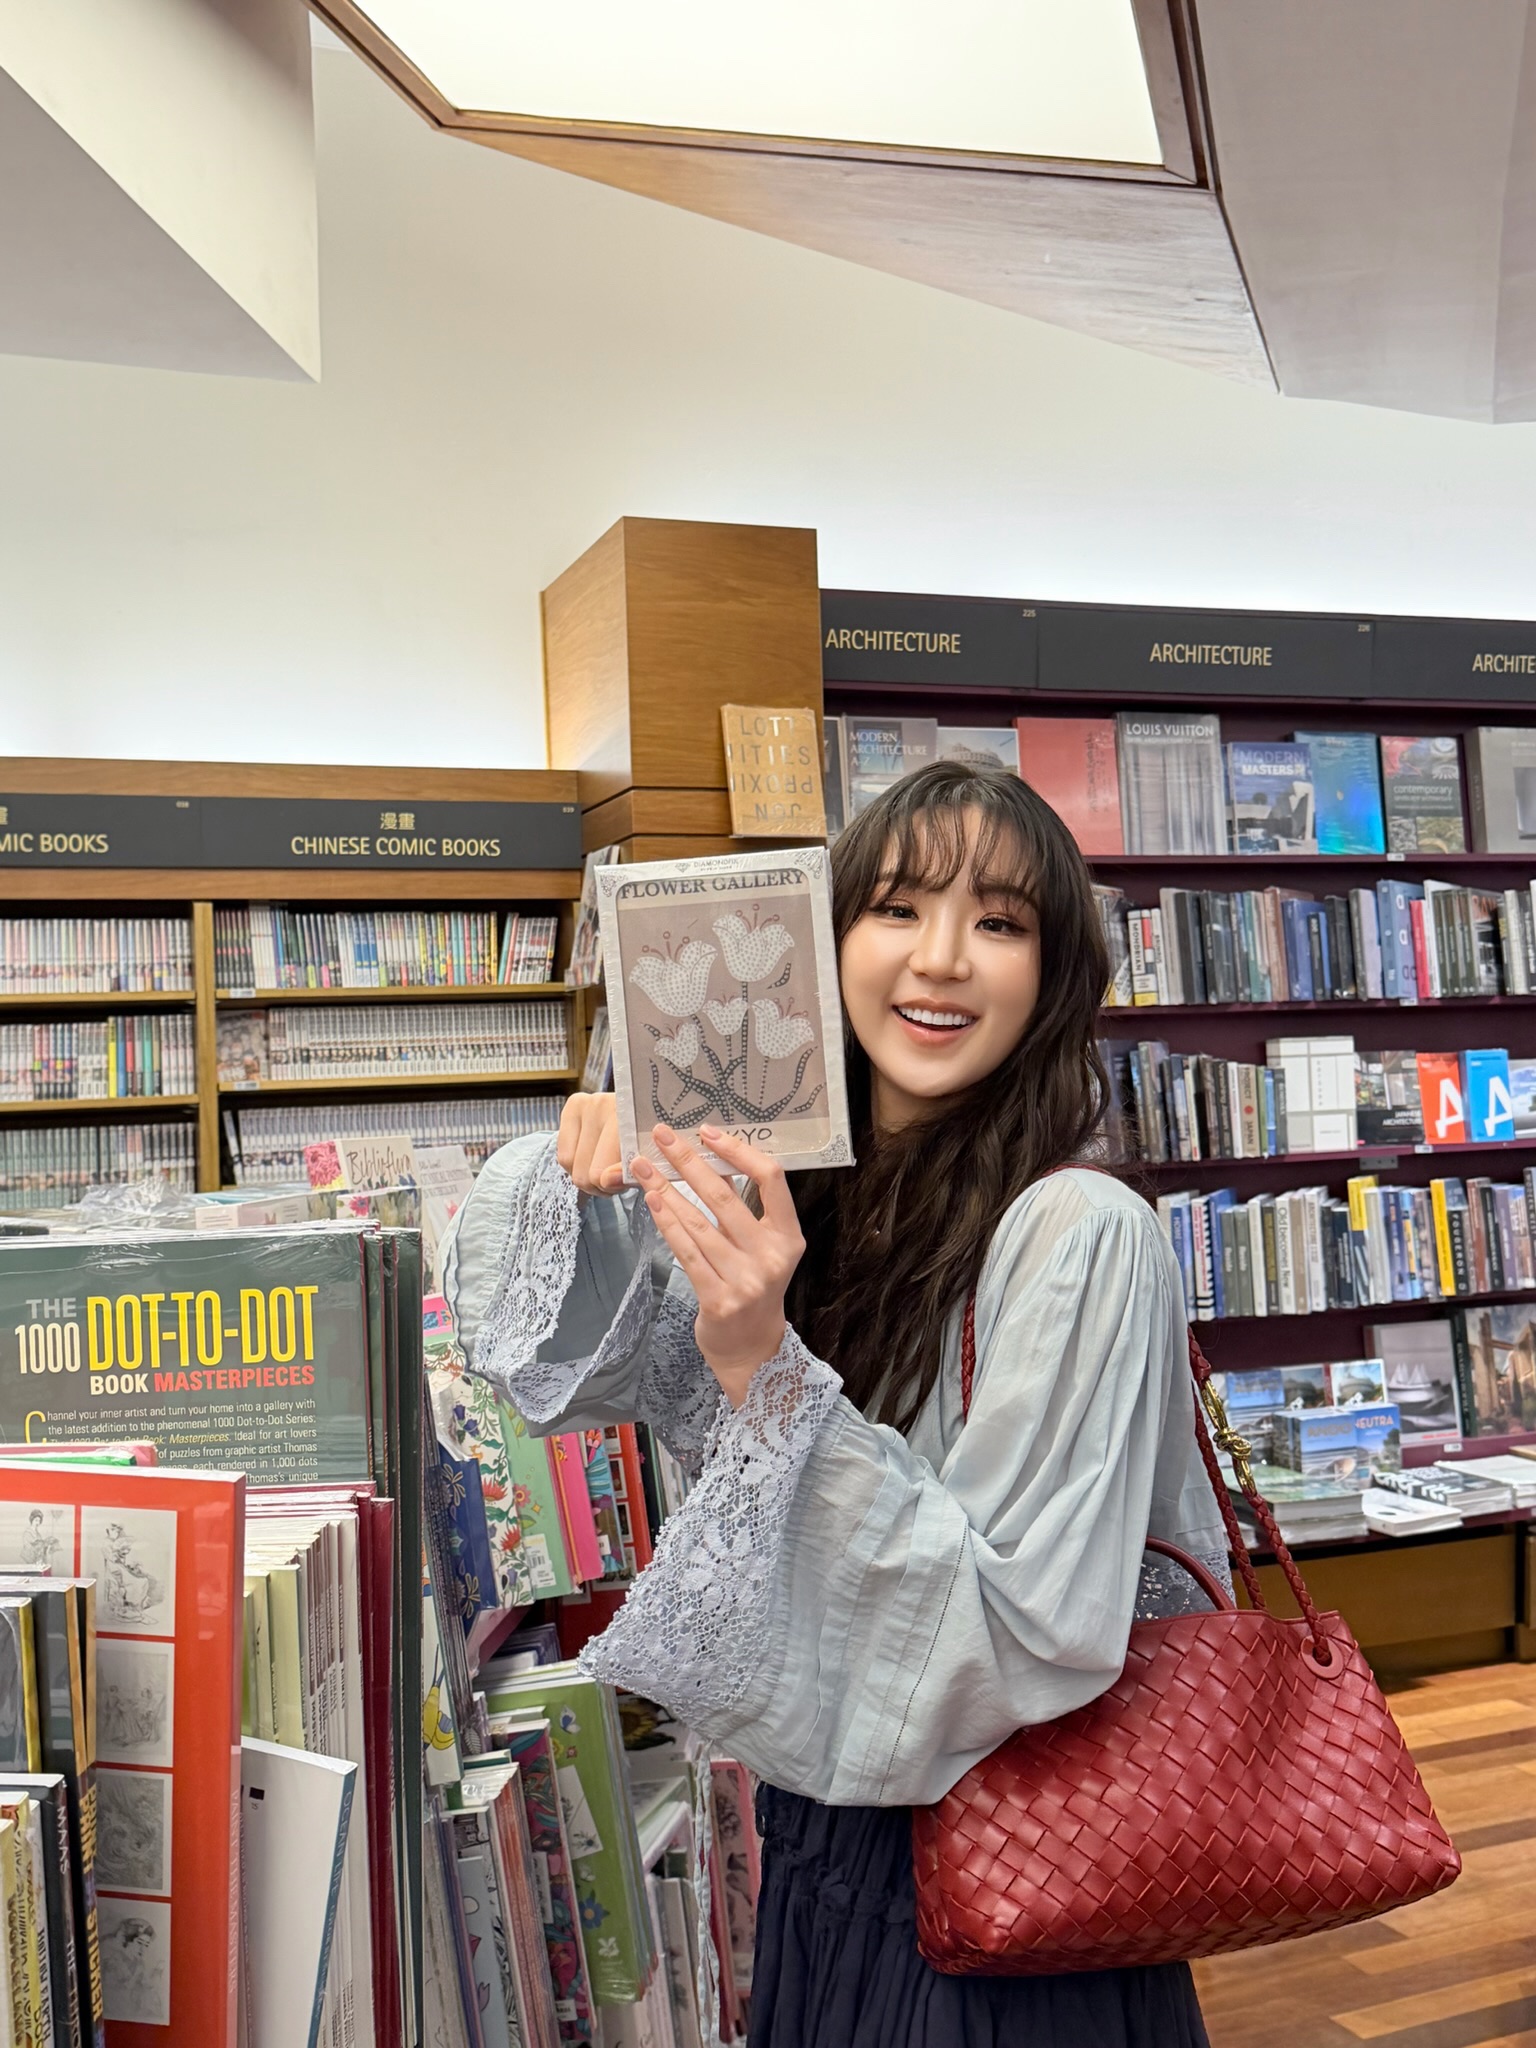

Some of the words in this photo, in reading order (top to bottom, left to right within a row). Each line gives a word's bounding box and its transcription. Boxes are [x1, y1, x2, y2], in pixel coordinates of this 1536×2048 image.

[1022, 609, 1036, 618] 225
[826, 629, 961, 654] ARCHITECTURE
[1149, 642, 1273, 667] ARCHITECTURE
[1472, 653, 1536, 674] ARCHITE
[740, 715, 795, 737] LOTT
[1126, 723, 1161, 736] LOUIS
[1163, 724, 1215, 737] VUITTON
[849, 732, 898, 743] MODERN
[850, 744, 928, 756] ARCHITECTURE
[1239, 750, 1305, 764] MODERN
[1241, 764, 1294, 776] MASTERS
[1393, 784, 1453, 797] contemporary
[39, 833, 109, 853] BOOKS
[291, 836, 370, 856] CHINESE
[376, 837, 437, 856] COMIC
[441, 838, 501, 857] BOOKS
[620, 875, 707, 900] FLOWER
[710, 869, 804, 893] GALLERY
[1132, 922, 1142, 974] MONDRIAN
[1242, 1066, 1254, 1101] PROJECT
[1246, 1120, 1256, 1149] JAPAN
[1277, 1206, 1288, 1227] Old
[1279, 1228, 1289, 1266] becomes
[1281, 1267, 1290, 1289] New
[26, 1297, 77, 1319] THE
[14, 1321, 81, 1374] 1000
[87, 1285, 319, 1371] DOT-TO-DOT
[90, 1372, 149, 1395] BOOK
[154, 1365, 315, 1393] MASTERPIECES
[79, 1411, 98, 1422] your
[100, 1409, 122, 1419] inner
[124, 1408, 148, 1418] artist
[150, 1406, 167, 1416] and
[168, 1405, 186, 1415] turn
[188, 1405, 207, 1416] your
[209, 1403, 234, 1414] home
[236, 1402, 254, 1412] into
[255, 1403, 262, 1411] a
[263, 1400, 294, 1413] gallery
[295, 1398, 316, 1409] with
[48, 1425, 63, 1435] the
[64, 1424, 90, 1434] latest
[91, 1422, 128, 1434] addition
[129, 1422, 139, 1432] to
[140, 1421, 155, 1431] the
[157, 1418, 211, 1431] phenomenal
[213, 1416, 235, 1428] 1000
[237, 1415, 284, 1427] Dot-to-Dot
[169, 1432, 232, 1445] Masterpieces.
[234, 1430, 257, 1441] Ideal
[259, 1429, 271, 1440] for
[274, 1429, 287, 1439] art
[290, 1428, 317, 1438] lovers
[158, 1448, 167, 1458] of
[169, 1446, 201, 1461] puzzles
[203, 1445, 223, 1456] from
[224, 1444, 257, 1458] graphic
[258, 1443, 281, 1454] artist
[283, 1442, 317, 1453] Thomas
[193, 1461, 214, 1471] each
[217, 1459, 257, 1470] rendered
[259, 1459, 268, 1469] in
[271, 1457, 296, 1469] 1,000
[298, 1456, 318, 1466] dots
[288, 1472, 319, 1483] unique
[230, 1789, 240, 1848] PAINT
[336, 1790, 352, 1857] OCEAN
[57, 1806, 69, 1875] MAAS
[229, 1856, 238, 1893] THE
[330, 1860, 343, 1898] LIFE
[228, 1899, 238, 1995] MASTERS
[67, 1940, 77, 1977] THE
[86, 1908, 103, 2023] STICKER
